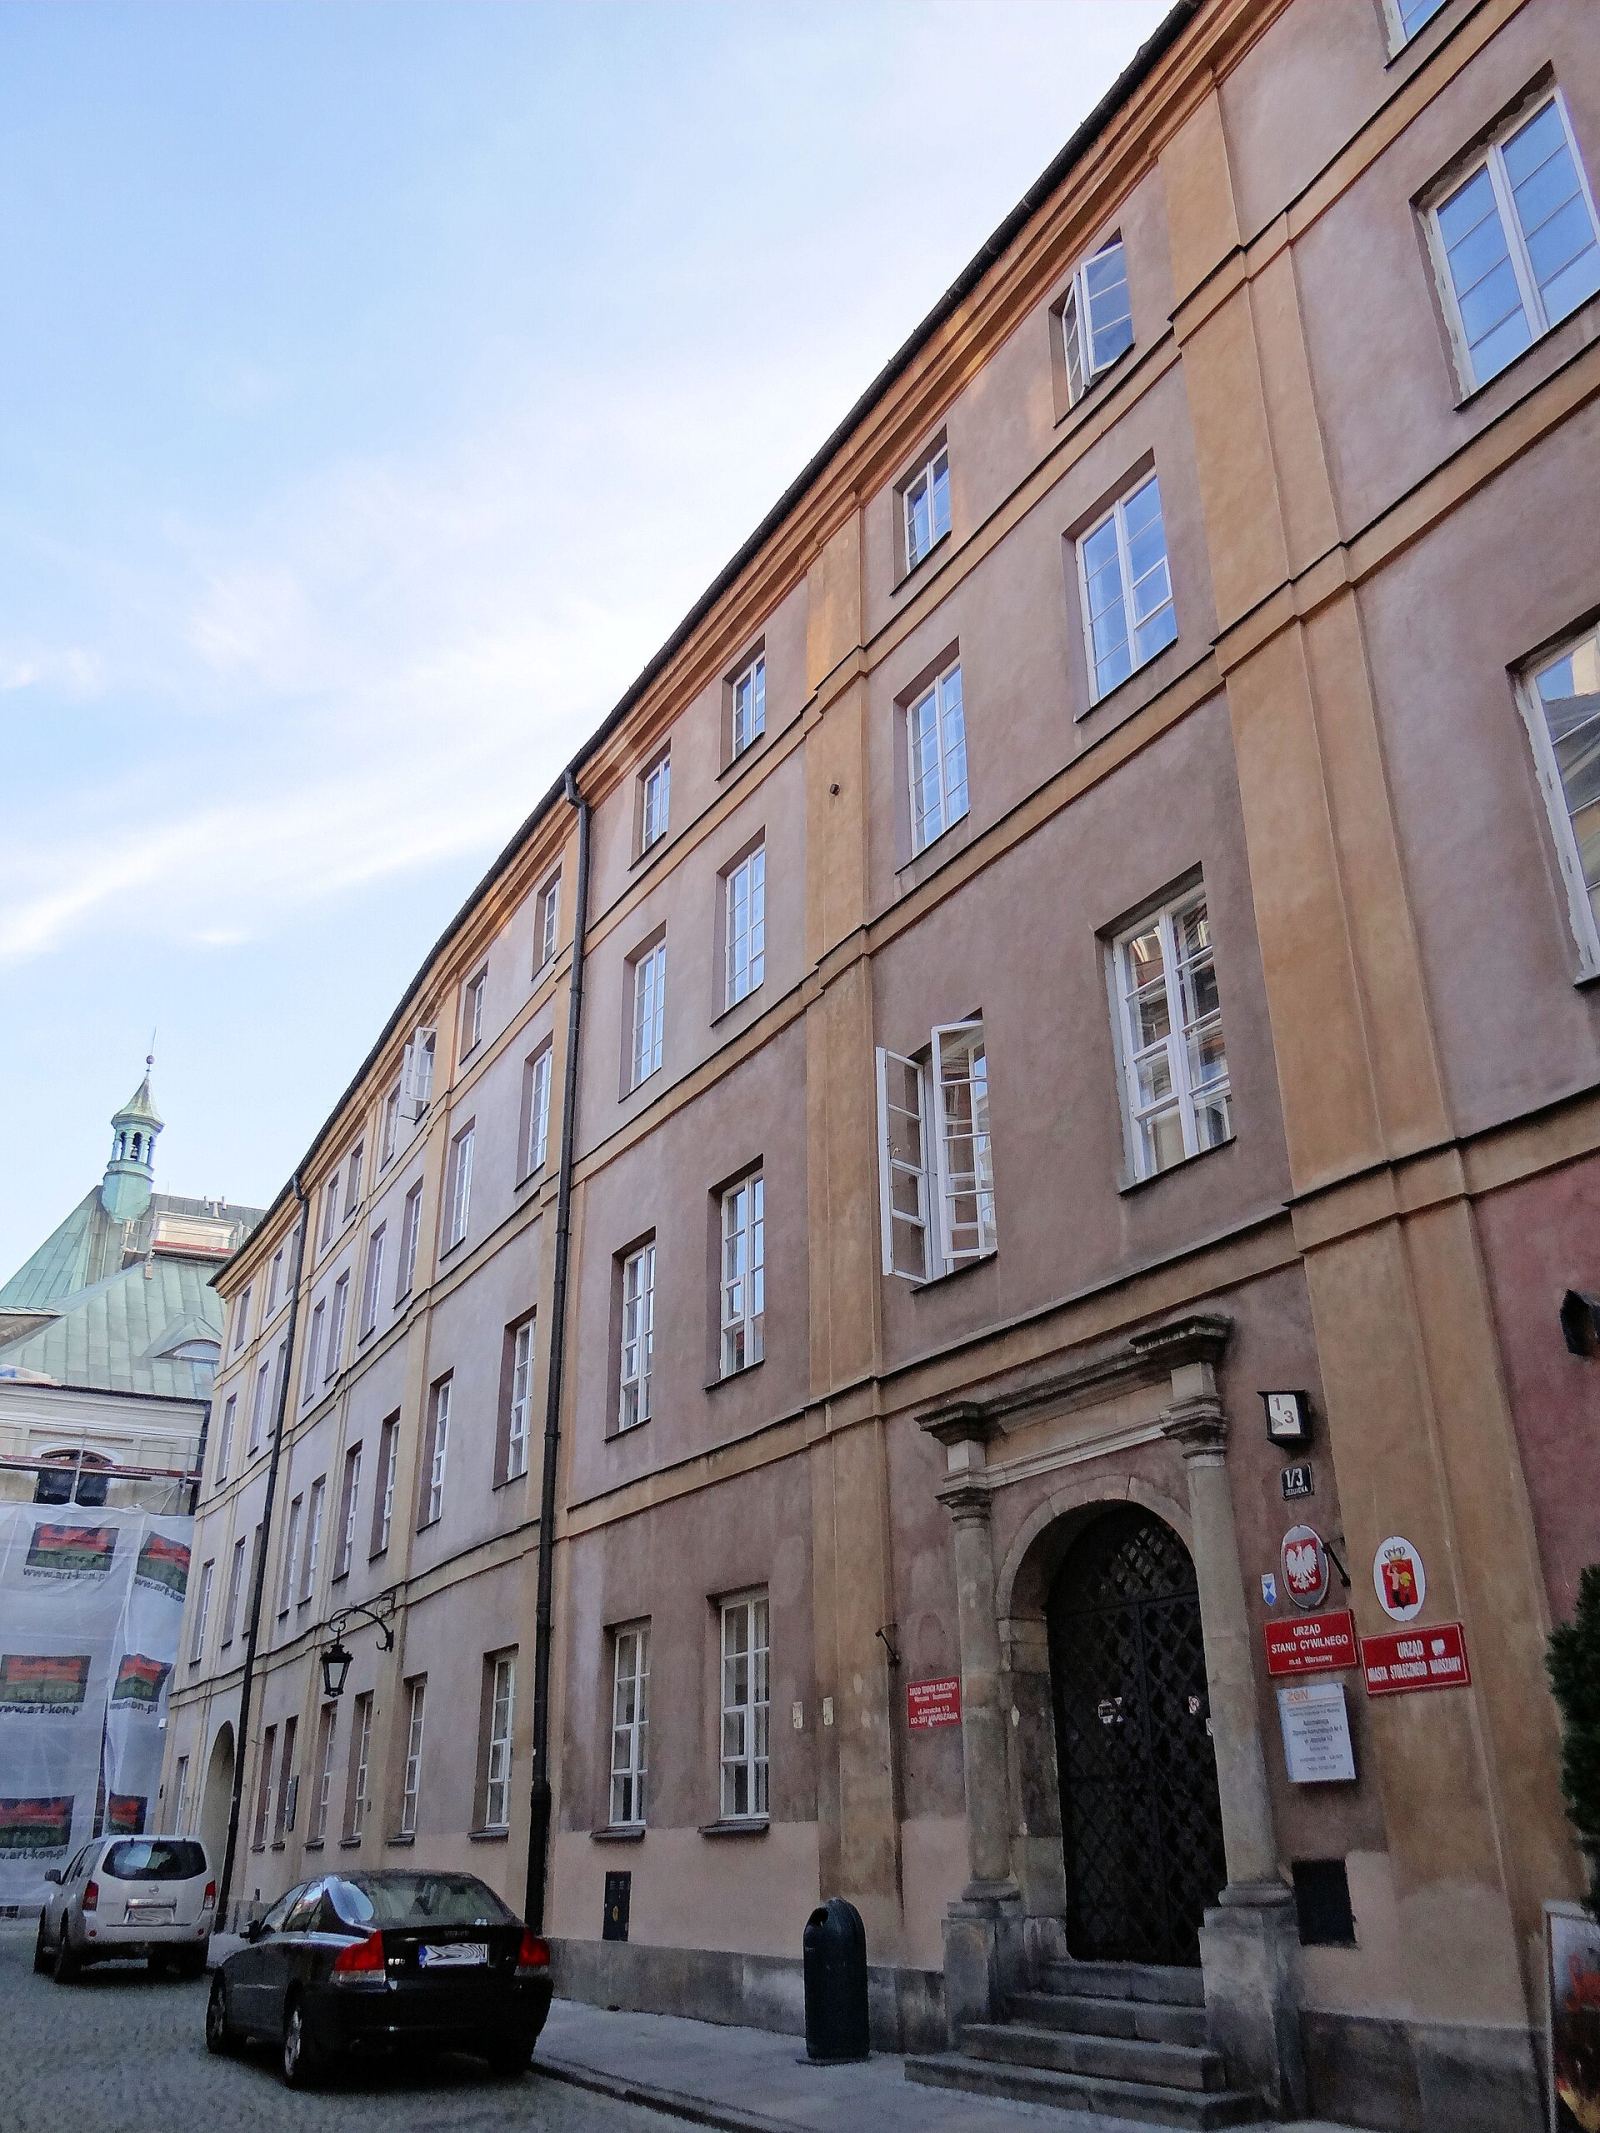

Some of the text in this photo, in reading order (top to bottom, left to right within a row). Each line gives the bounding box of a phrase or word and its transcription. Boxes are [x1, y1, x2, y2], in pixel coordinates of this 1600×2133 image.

[1274, 1397, 1281, 1411] 1
[1283, 1409, 1295, 1424] 3
[1284, 1467, 1304, 1488] 1/3
[23, 1567, 106, 1582] www.art-kon.p
[1292, 1623, 1321, 1637] URZĄD
[1271, 1633, 1349, 1655] STANU CYWILNEGO
[1396, 1639, 1425, 1660] URZĄD
